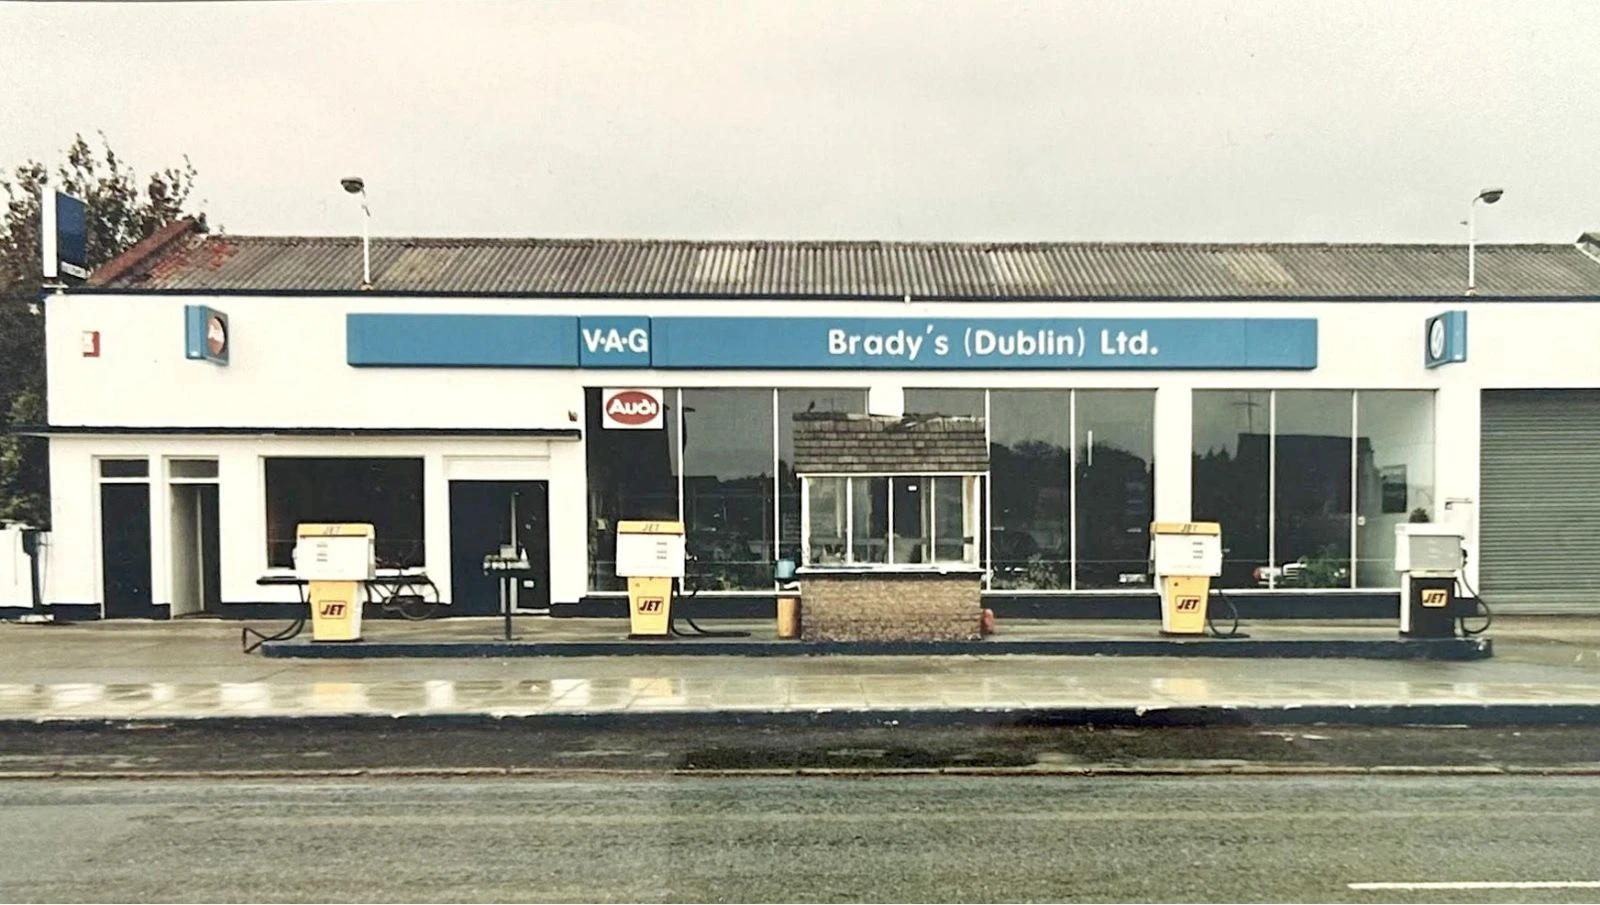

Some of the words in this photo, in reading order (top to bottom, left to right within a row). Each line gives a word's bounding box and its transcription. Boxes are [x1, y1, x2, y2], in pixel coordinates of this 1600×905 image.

[827, 324, 949, 361] Brady's
[963, 326, 1086, 358] (Dublin)
[1100, 328, 1159, 356] Ltd.
[608, 398, 657, 416] Audi
[1176, 598, 1201, 611] JET
[1423, 592, 1446, 604] JET
[320, 603, 346, 616] JET
[638, 599, 662, 612] JET
